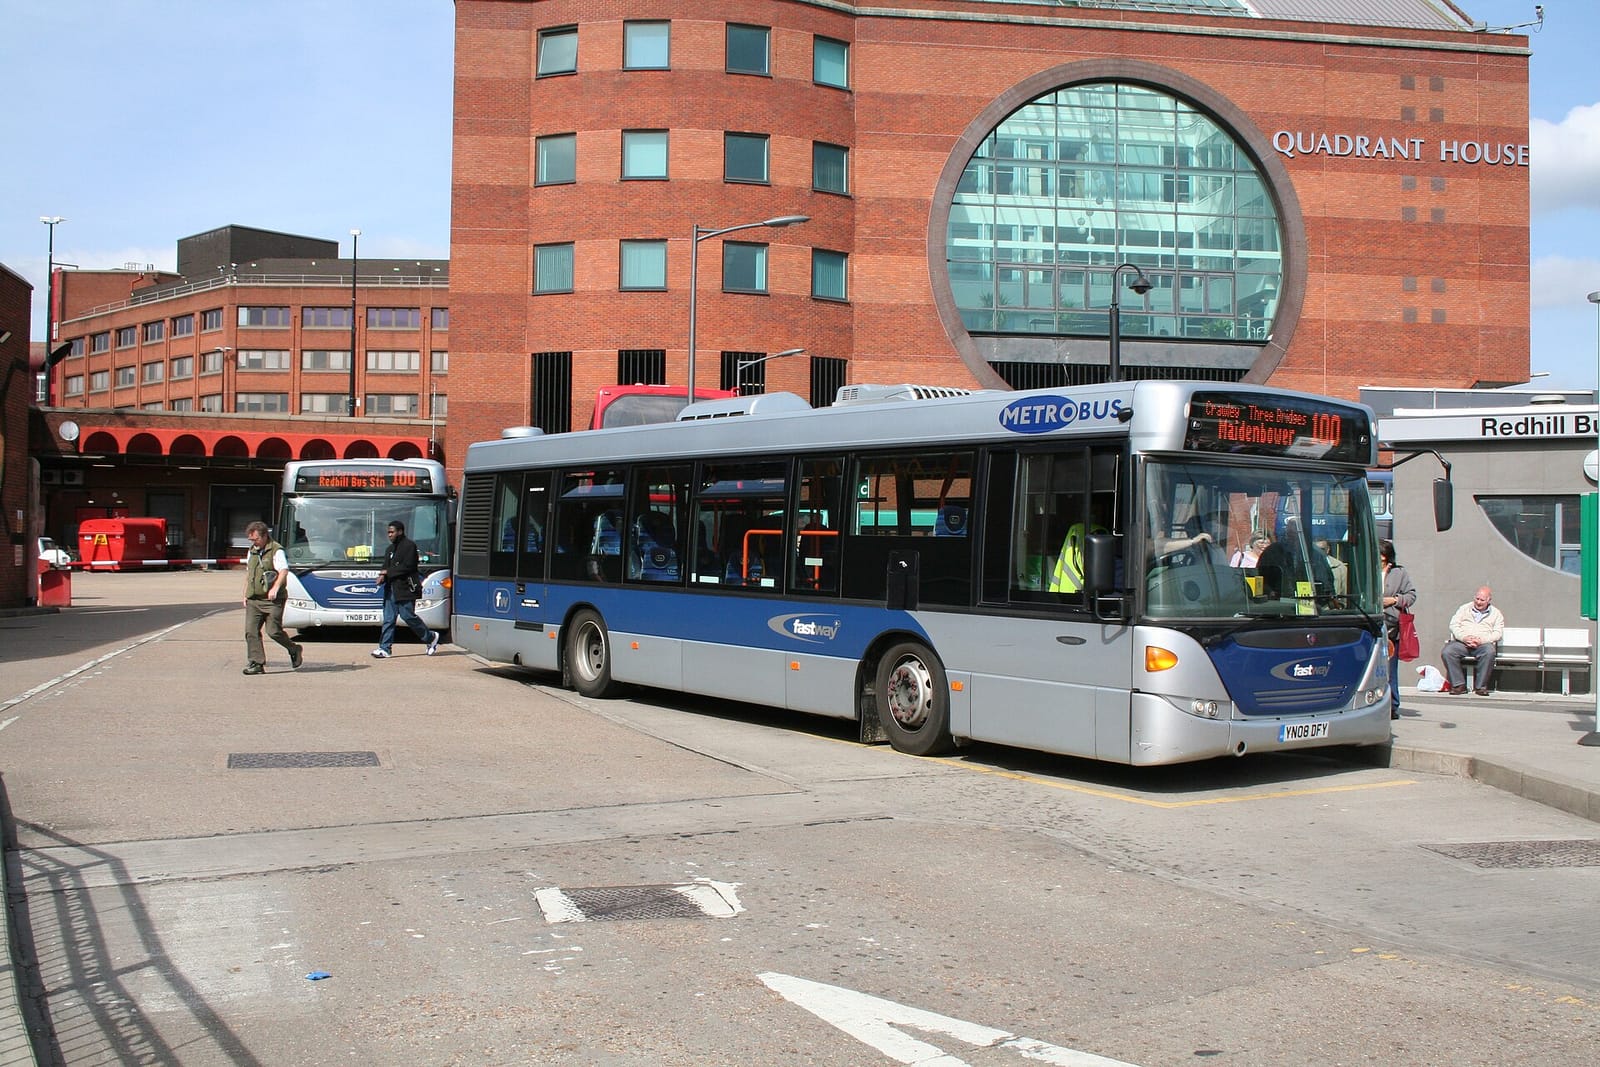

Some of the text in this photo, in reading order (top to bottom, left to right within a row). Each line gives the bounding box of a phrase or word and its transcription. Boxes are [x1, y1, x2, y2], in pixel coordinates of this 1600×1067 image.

[1272, 130, 1529, 166] QUADRANT HOUSE
[1002, 398, 1122, 426] METROBUS
[1205, 400, 1308, 426] Crawley Three Bridges
[1217, 418, 1297, 446] Maidenbower
[1311, 412, 1342, 447] 100
[1481, 415, 1565, 436] Redhill
[319, 476, 386, 488] Redhill Bus Stn
[392, 470, 417, 487] 100
[860, 484, 868, 495] C
[793, 618, 838, 640] fastway
[1293, 663, 1330, 677] fastway
[1285, 722, 1328, 739] YN08 DFY
